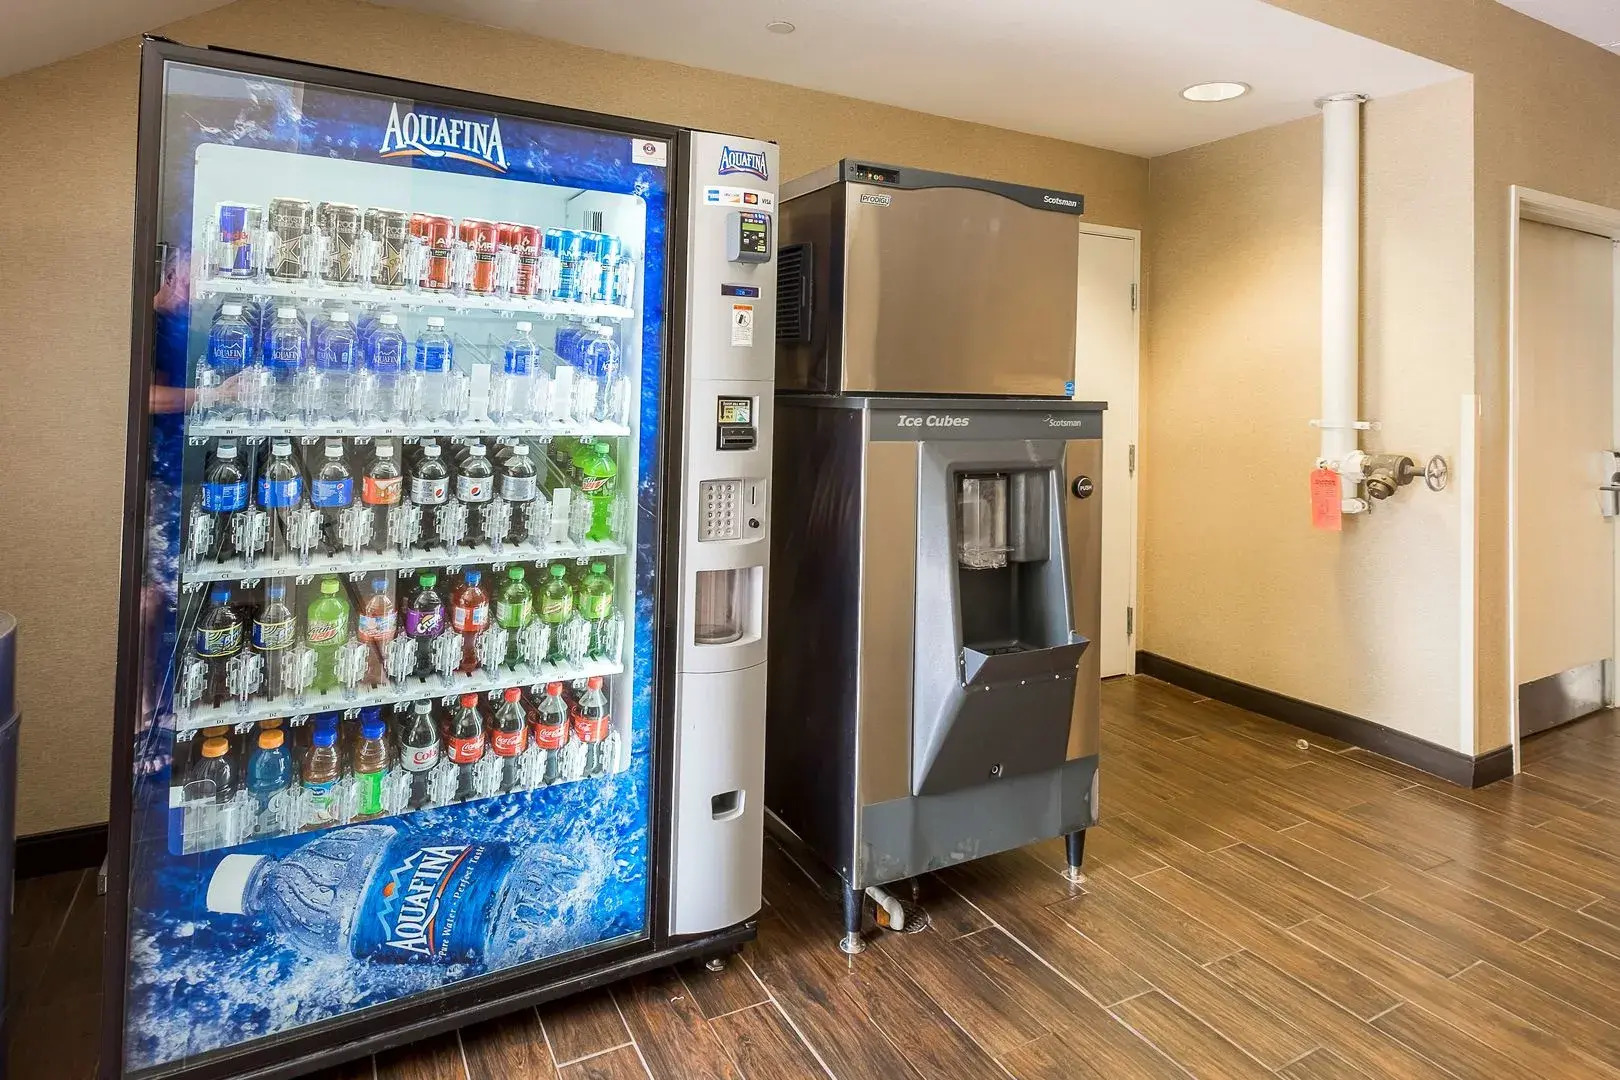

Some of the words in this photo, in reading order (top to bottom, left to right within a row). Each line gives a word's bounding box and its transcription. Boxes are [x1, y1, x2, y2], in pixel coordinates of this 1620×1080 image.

[379, 102, 508, 168] AQUAFINA
[720, 146, 768, 178] AQUAFINA
[1043, 195, 1077, 207] Scotsman
[213, 347, 243, 358] AQUAFIN
[897, 415, 922, 427] Ice
[926, 415, 970, 427] Cubes
[1049, 419, 1082, 427] Scotsman
[386, 844, 470, 957] AQUAFINA
